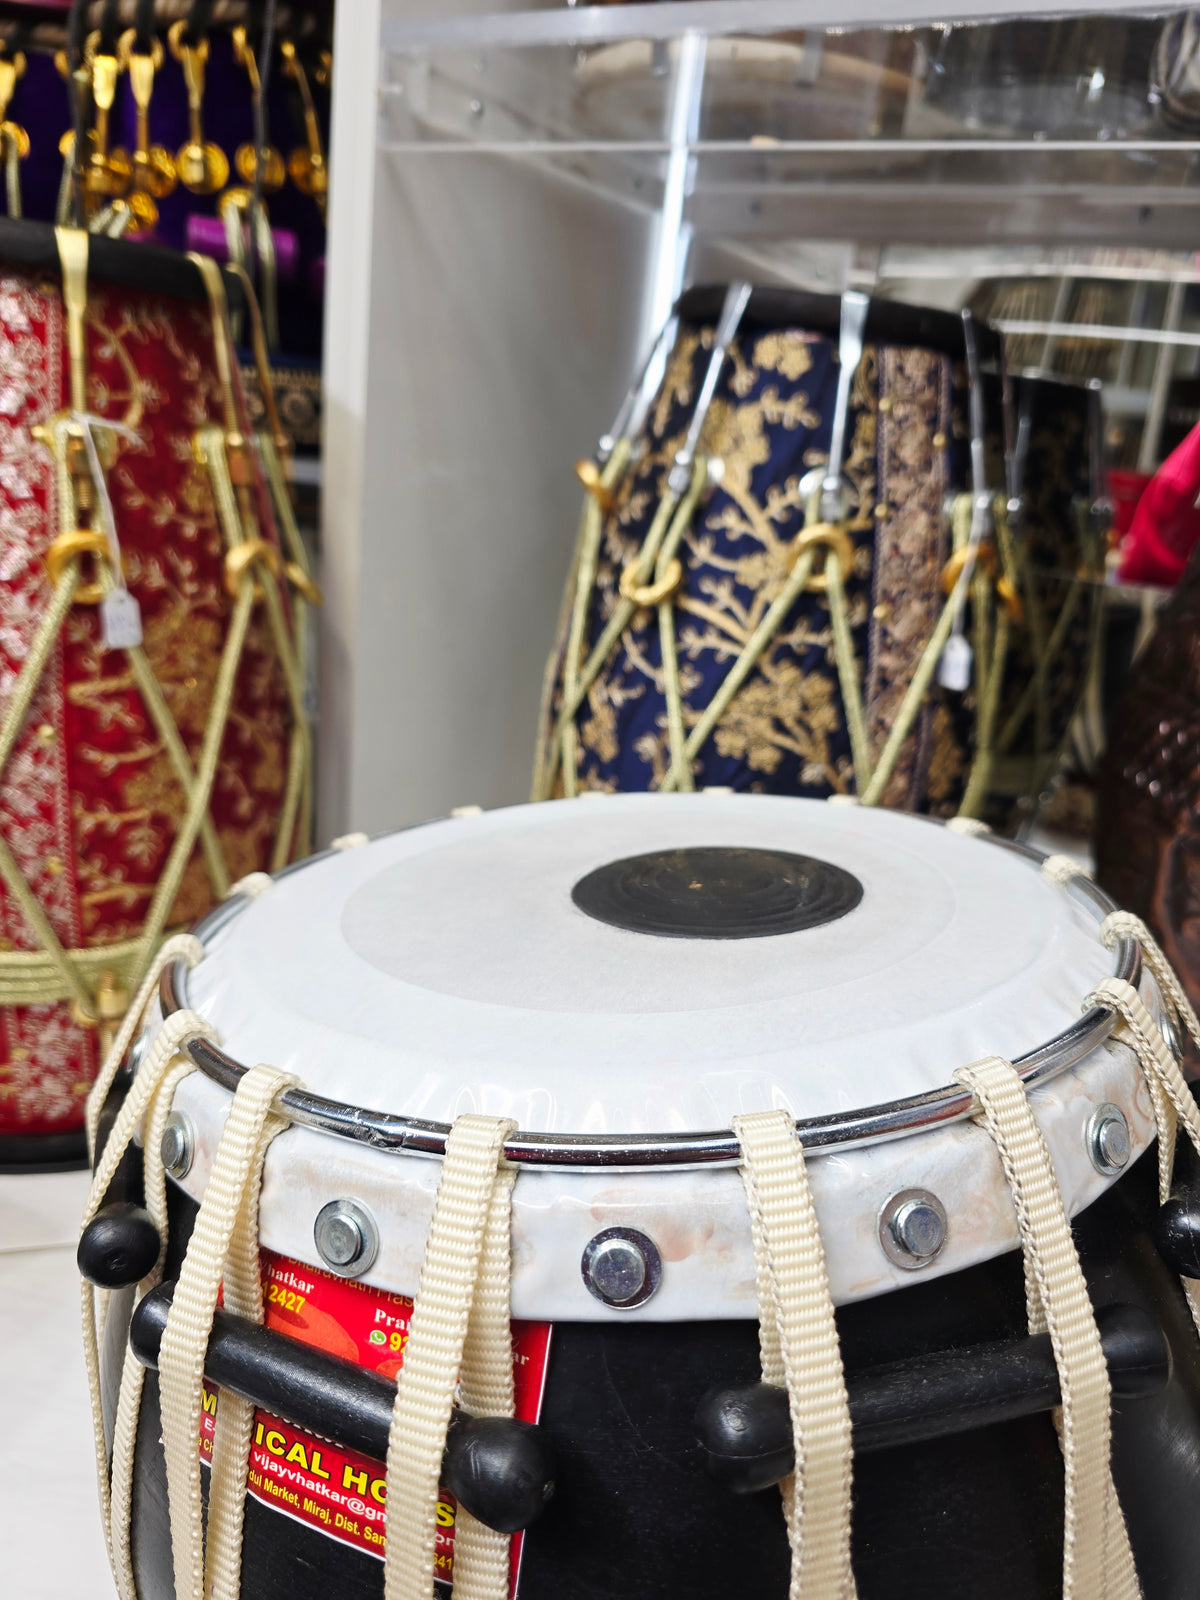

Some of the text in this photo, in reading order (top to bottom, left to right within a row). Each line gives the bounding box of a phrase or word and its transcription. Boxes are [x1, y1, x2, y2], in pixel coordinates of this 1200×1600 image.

[262, 1281, 305, 1313] 12427
[264, 1478, 300, 1509] Market,
[303, 1498, 332, 1524] Miraj,
[335, 1513, 360, 1535] Dist.
[364, 1526, 386, 1546] San
